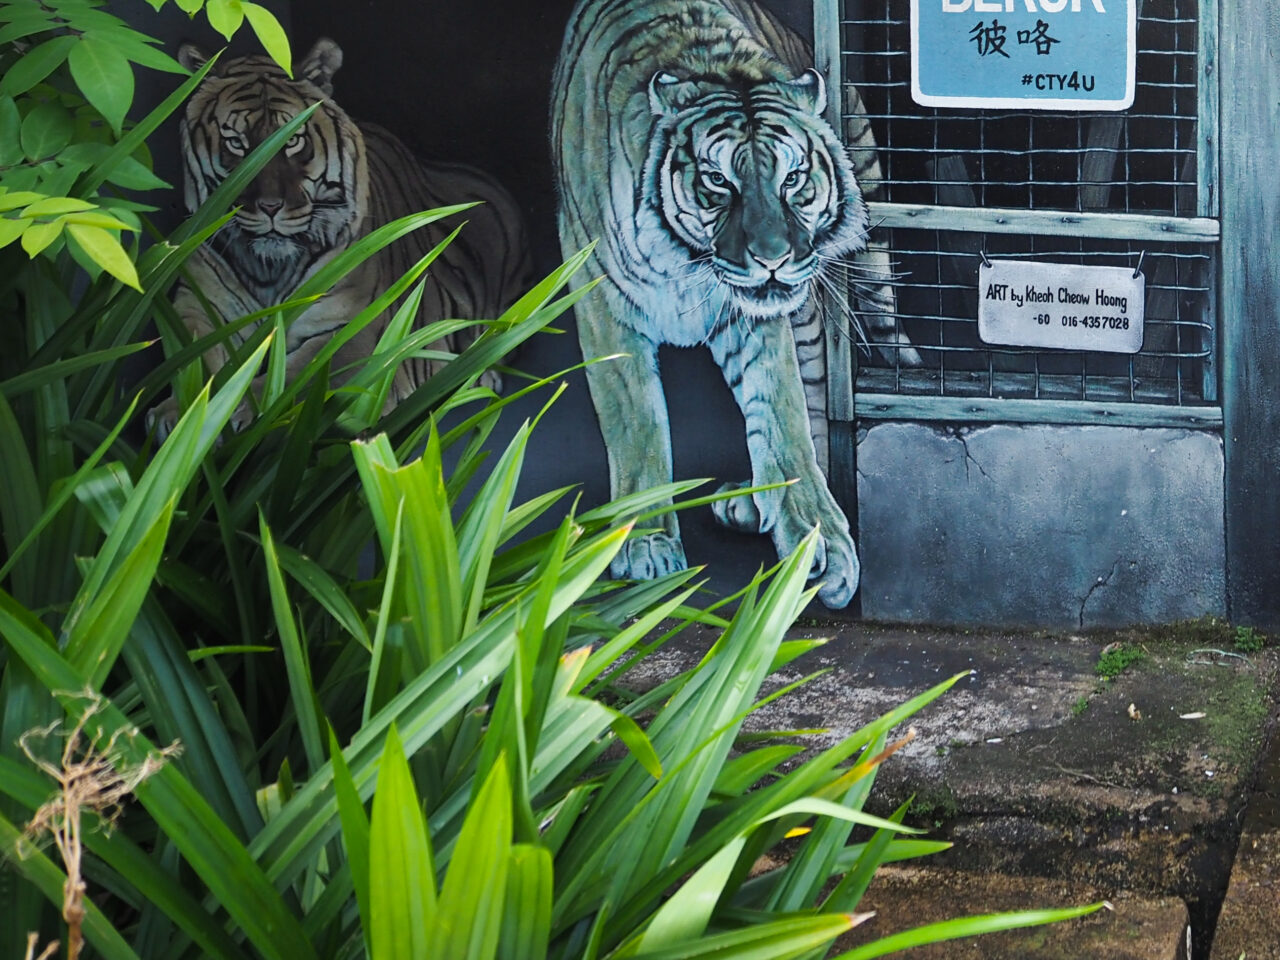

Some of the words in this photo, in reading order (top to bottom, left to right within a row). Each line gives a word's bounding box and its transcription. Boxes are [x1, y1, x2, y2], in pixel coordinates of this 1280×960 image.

[969, 19, 1061, 58] 彼咯
[1021, 71, 1095, 91] #CTY4U
[986, 283, 1009, 300] ART
[1011, 288, 1023, 307] by
[1025, 284, 1053, 303] Kheoh
[1058, 287, 1090, 305] Cheow
[1095, 288, 1127, 313] Hoong
[1061, 315, 1129, 330] 016-4357028
